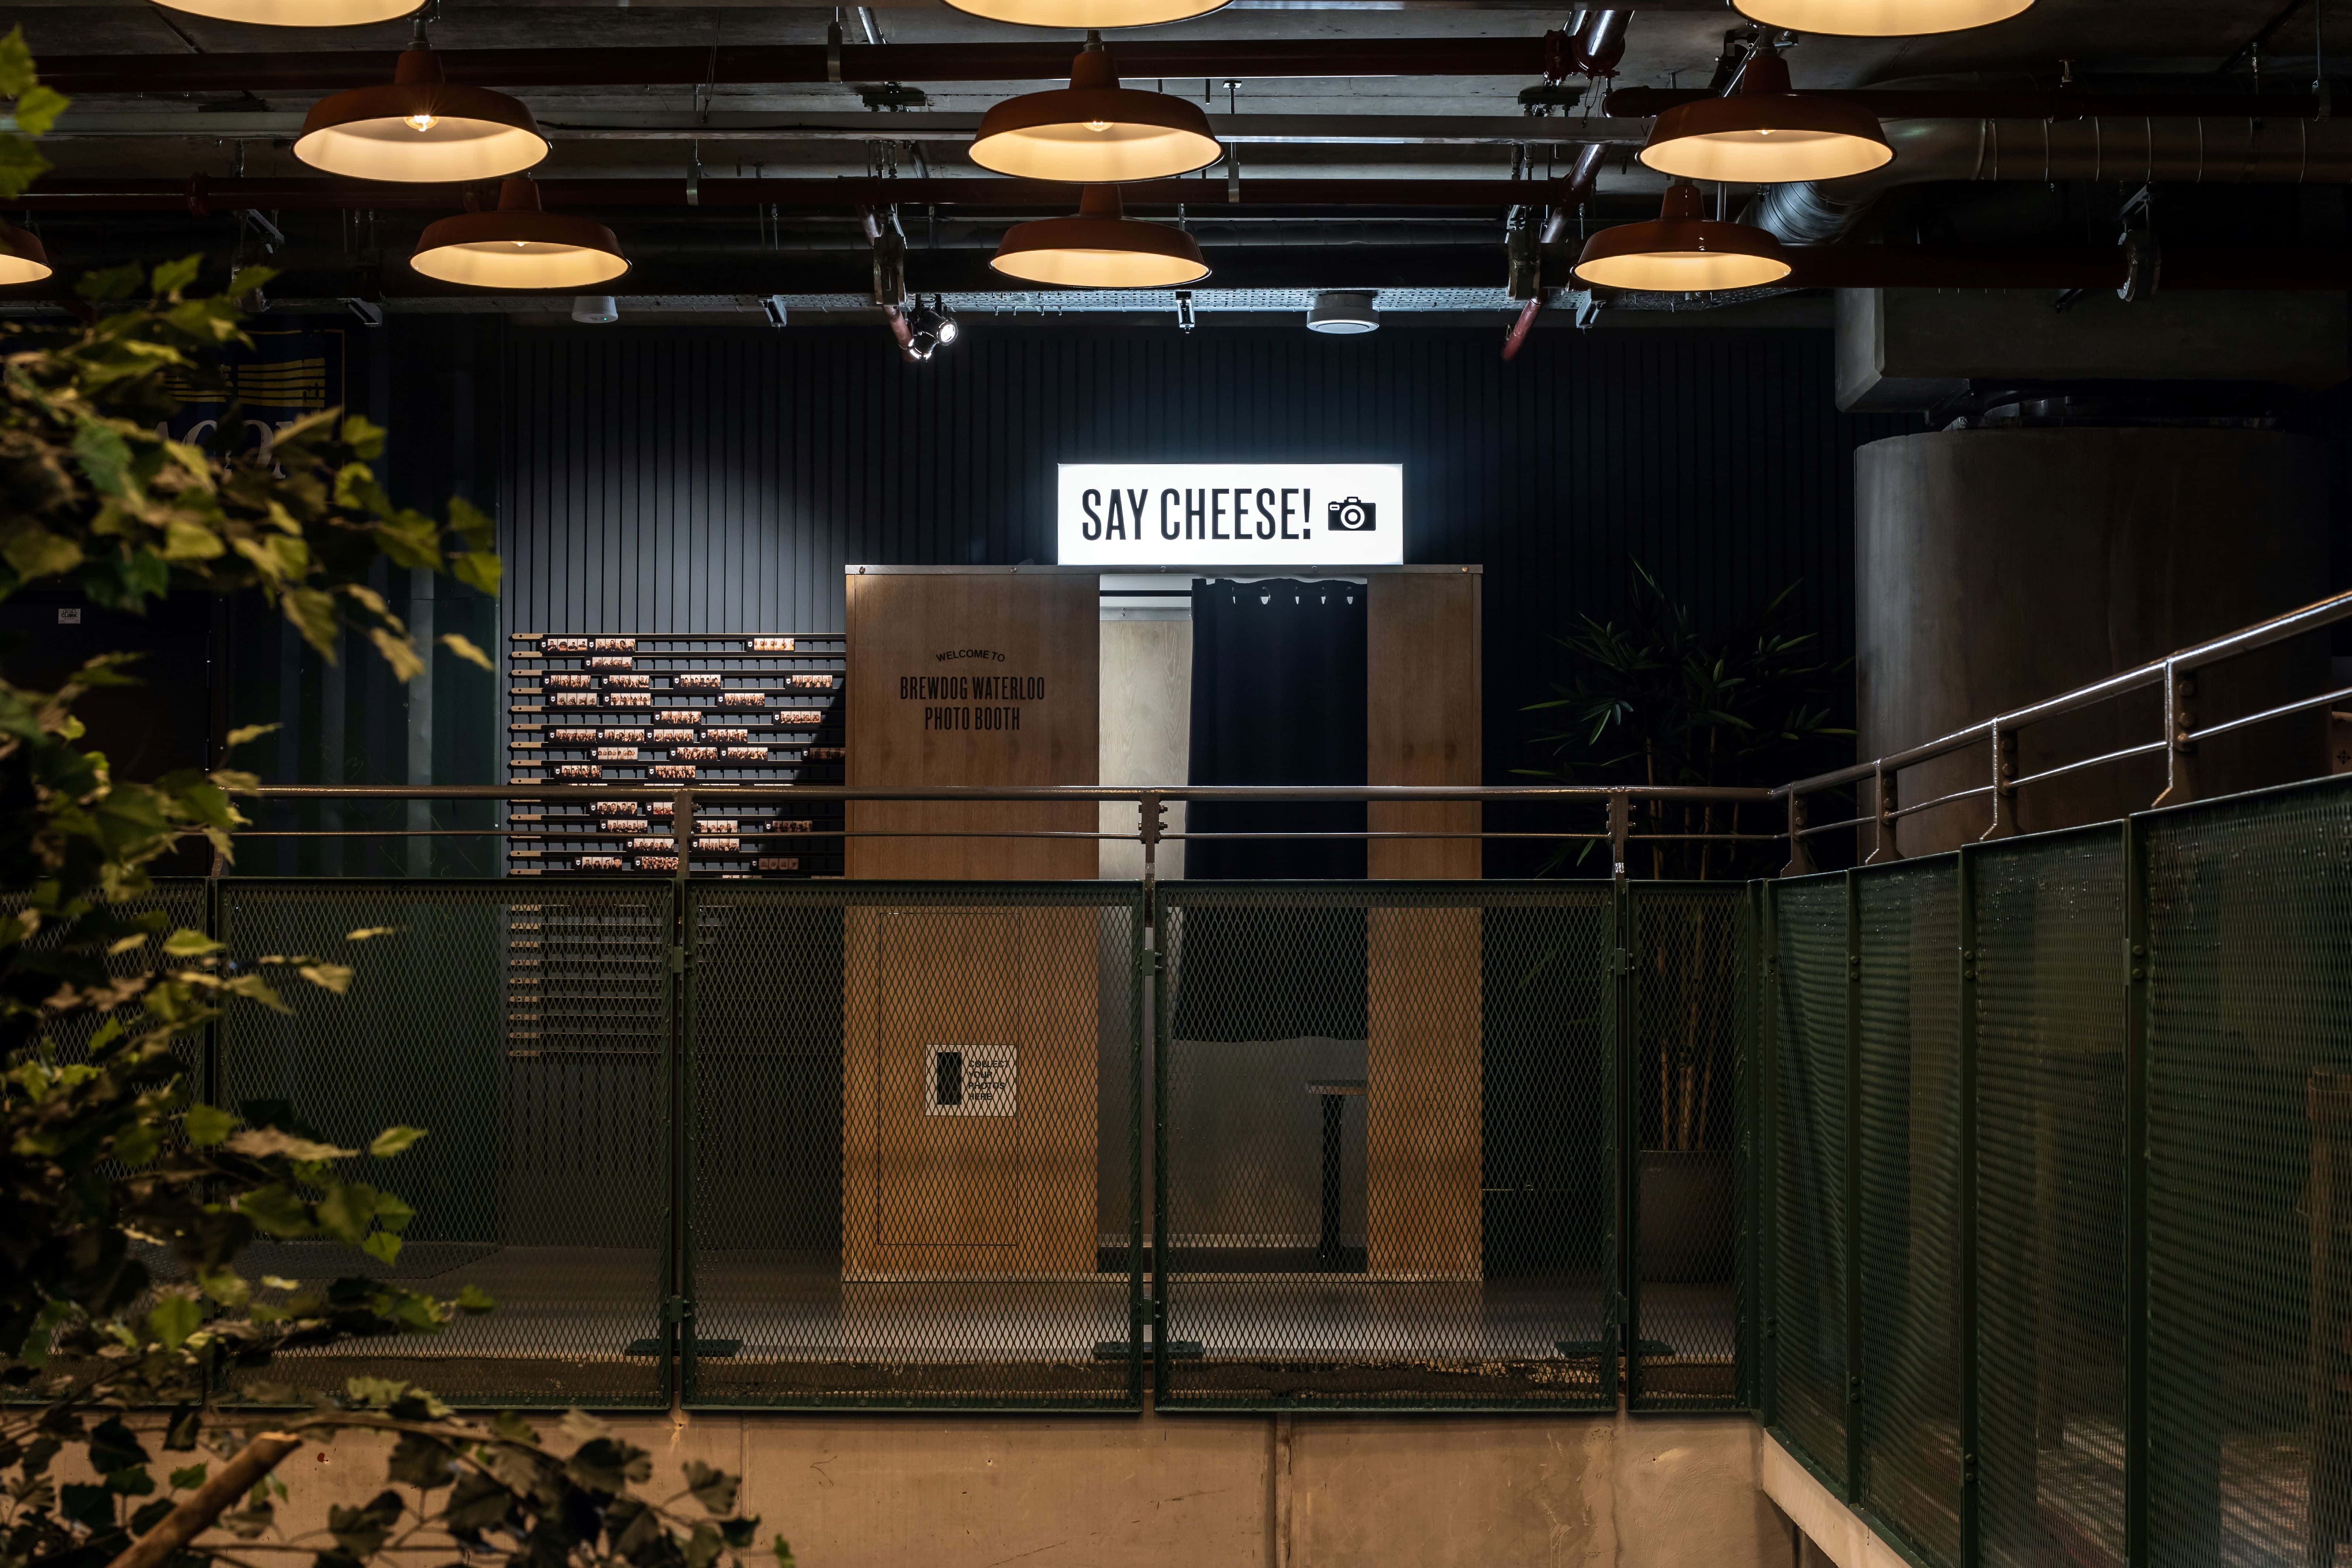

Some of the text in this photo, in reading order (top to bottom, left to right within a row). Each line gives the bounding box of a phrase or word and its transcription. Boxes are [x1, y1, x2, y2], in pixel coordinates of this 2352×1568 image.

[1082, 488, 1311, 541] SAY CHEESE!
[936, 649, 1005, 662] WELCOME TO
[900, 676, 1044, 700] BREWDOG WATERLOO
[925, 707, 1020, 730] PHOTO BOOTH
